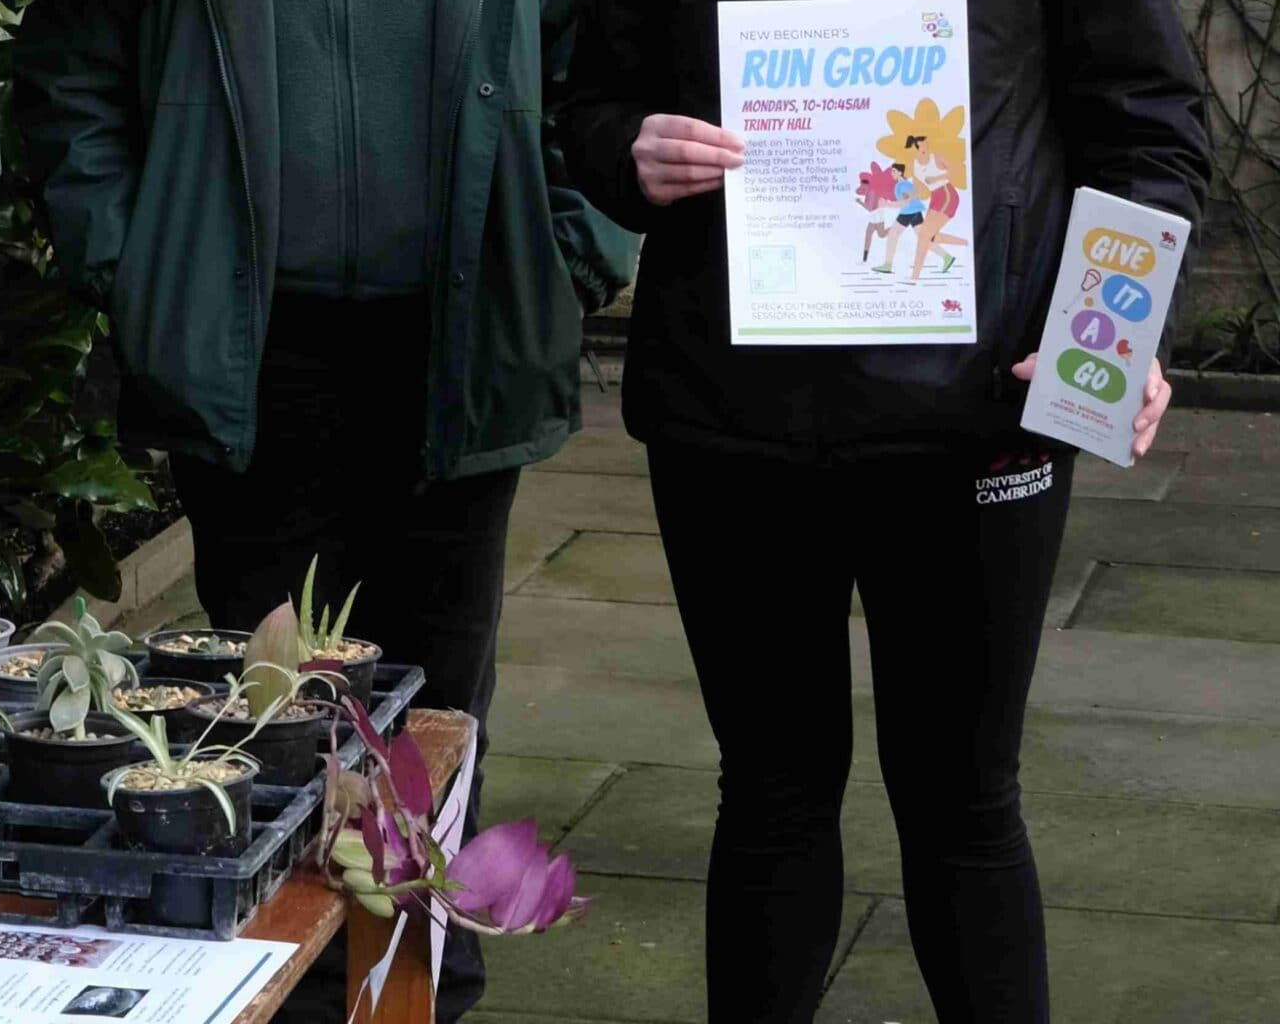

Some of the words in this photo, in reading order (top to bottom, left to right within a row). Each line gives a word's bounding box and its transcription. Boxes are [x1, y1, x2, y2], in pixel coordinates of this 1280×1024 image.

[739, 30, 771, 40] NEW
[773, 28, 850, 39] BEGINNER'S
[741, 47, 814, 89] RUN
[823, 44, 946, 87] GROUP
[741, 98, 799, 113] MONDAYS,
[802, 96, 871, 111] 10-10:45AM
[743, 118, 784, 131] TRINITY
[785, 117, 812, 130] HALL
[775, 147, 813, 156] running
[785, 138, 814, 147] Trinity
[744, 166, 770, 174] Jesus
[772, 166, 804, 174] Green,
[805, 165, 847, 173] followed
[1089, 235, 1150, 270] GIVE
[1112, 282, 1144, 310] IT
[1080, 316, 1100, 343] A
[1073, 360, 1110, 391] GO
[976, 467, 1042, 490] UNIVERSITY
[1042, 462, 1053, 474] OF
[976, 474, 1053, 504] CAMBRIDGE
